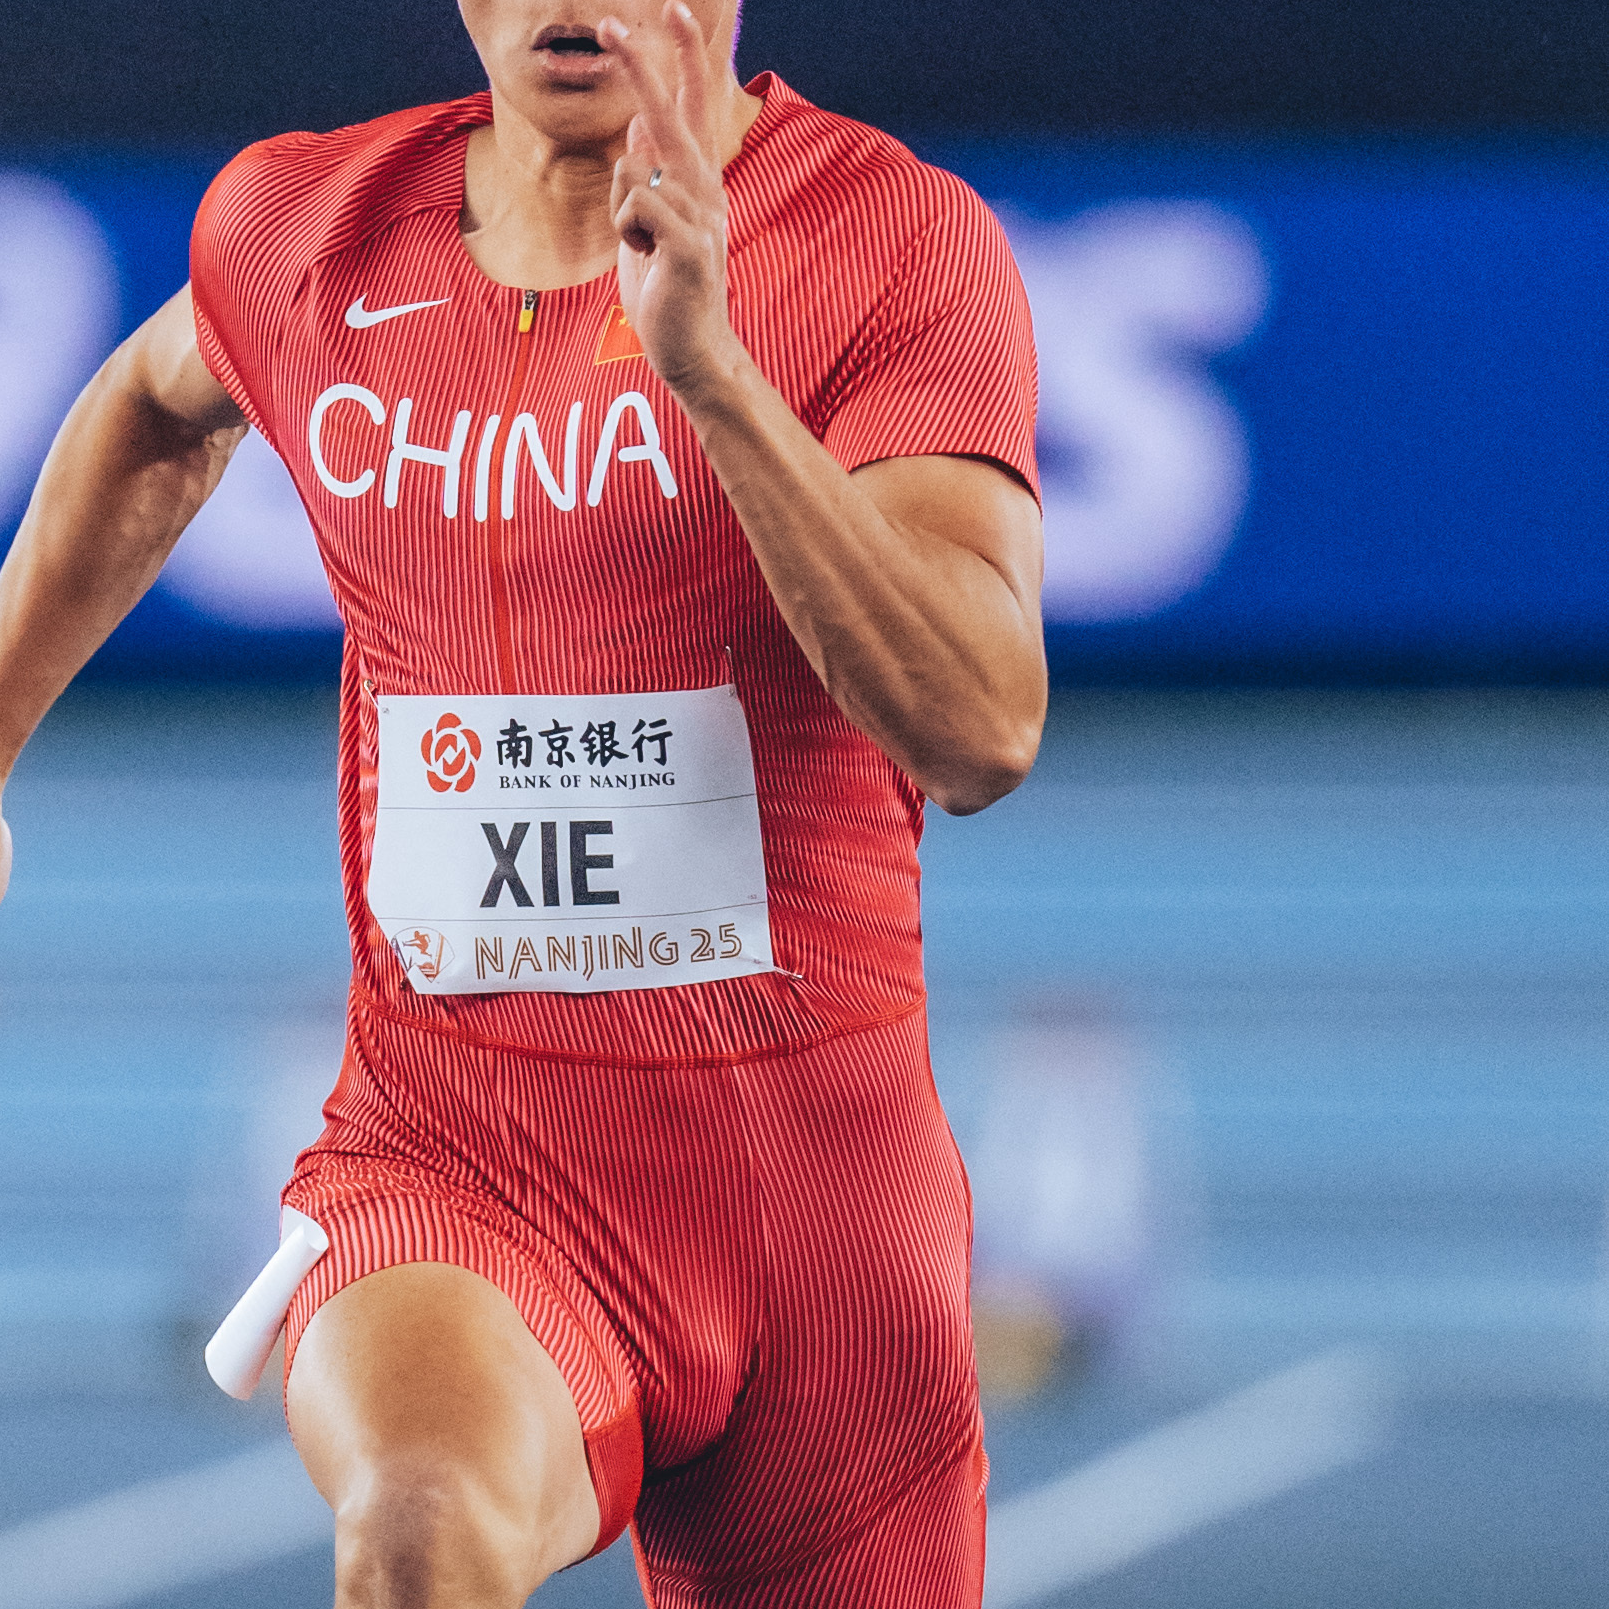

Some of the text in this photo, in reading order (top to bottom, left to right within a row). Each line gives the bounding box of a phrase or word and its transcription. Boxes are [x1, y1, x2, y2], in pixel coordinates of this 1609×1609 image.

[309, 383, 679, 522] CHINA
[496, 717, 674, 769] 南京银行
[499, 772, 676, 790] BANK OF NANJING
[479, 820, 621, 909] XIE
[475, 922, 743, 982] NANJING 25
